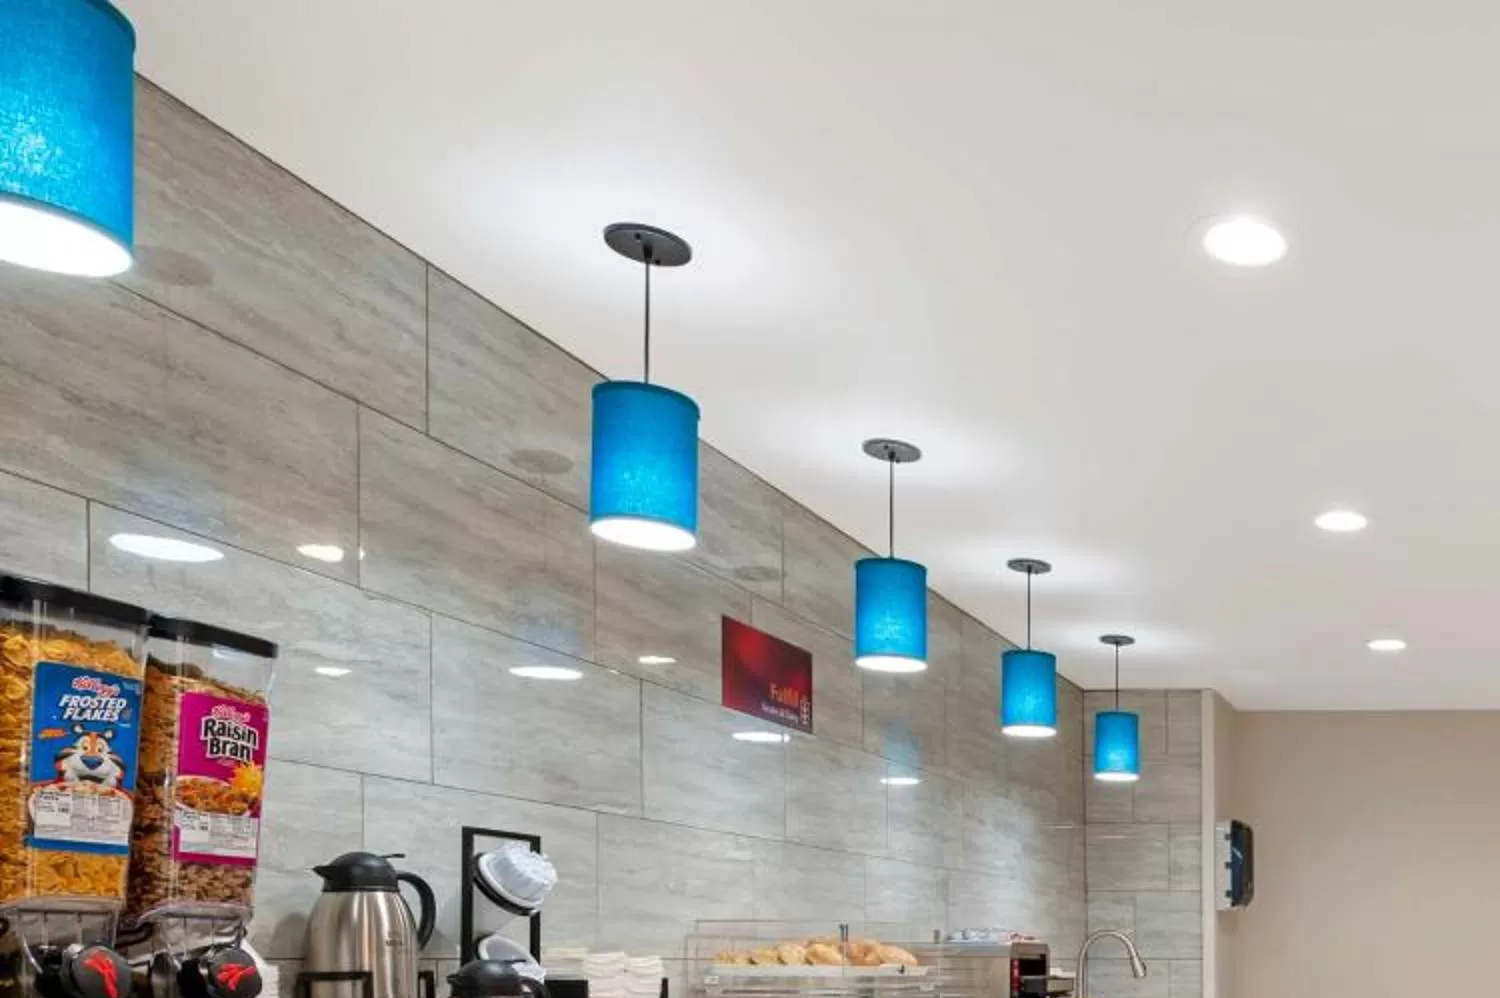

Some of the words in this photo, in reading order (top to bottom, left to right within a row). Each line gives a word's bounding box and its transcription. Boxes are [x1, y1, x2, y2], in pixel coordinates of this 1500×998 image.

[58, 694, 127, 711] FROSTED
[62, 707, 119, 722] FLAKES
[203, 717, 257, 747] Raisin
[208, 737, 250, 762] Bran
